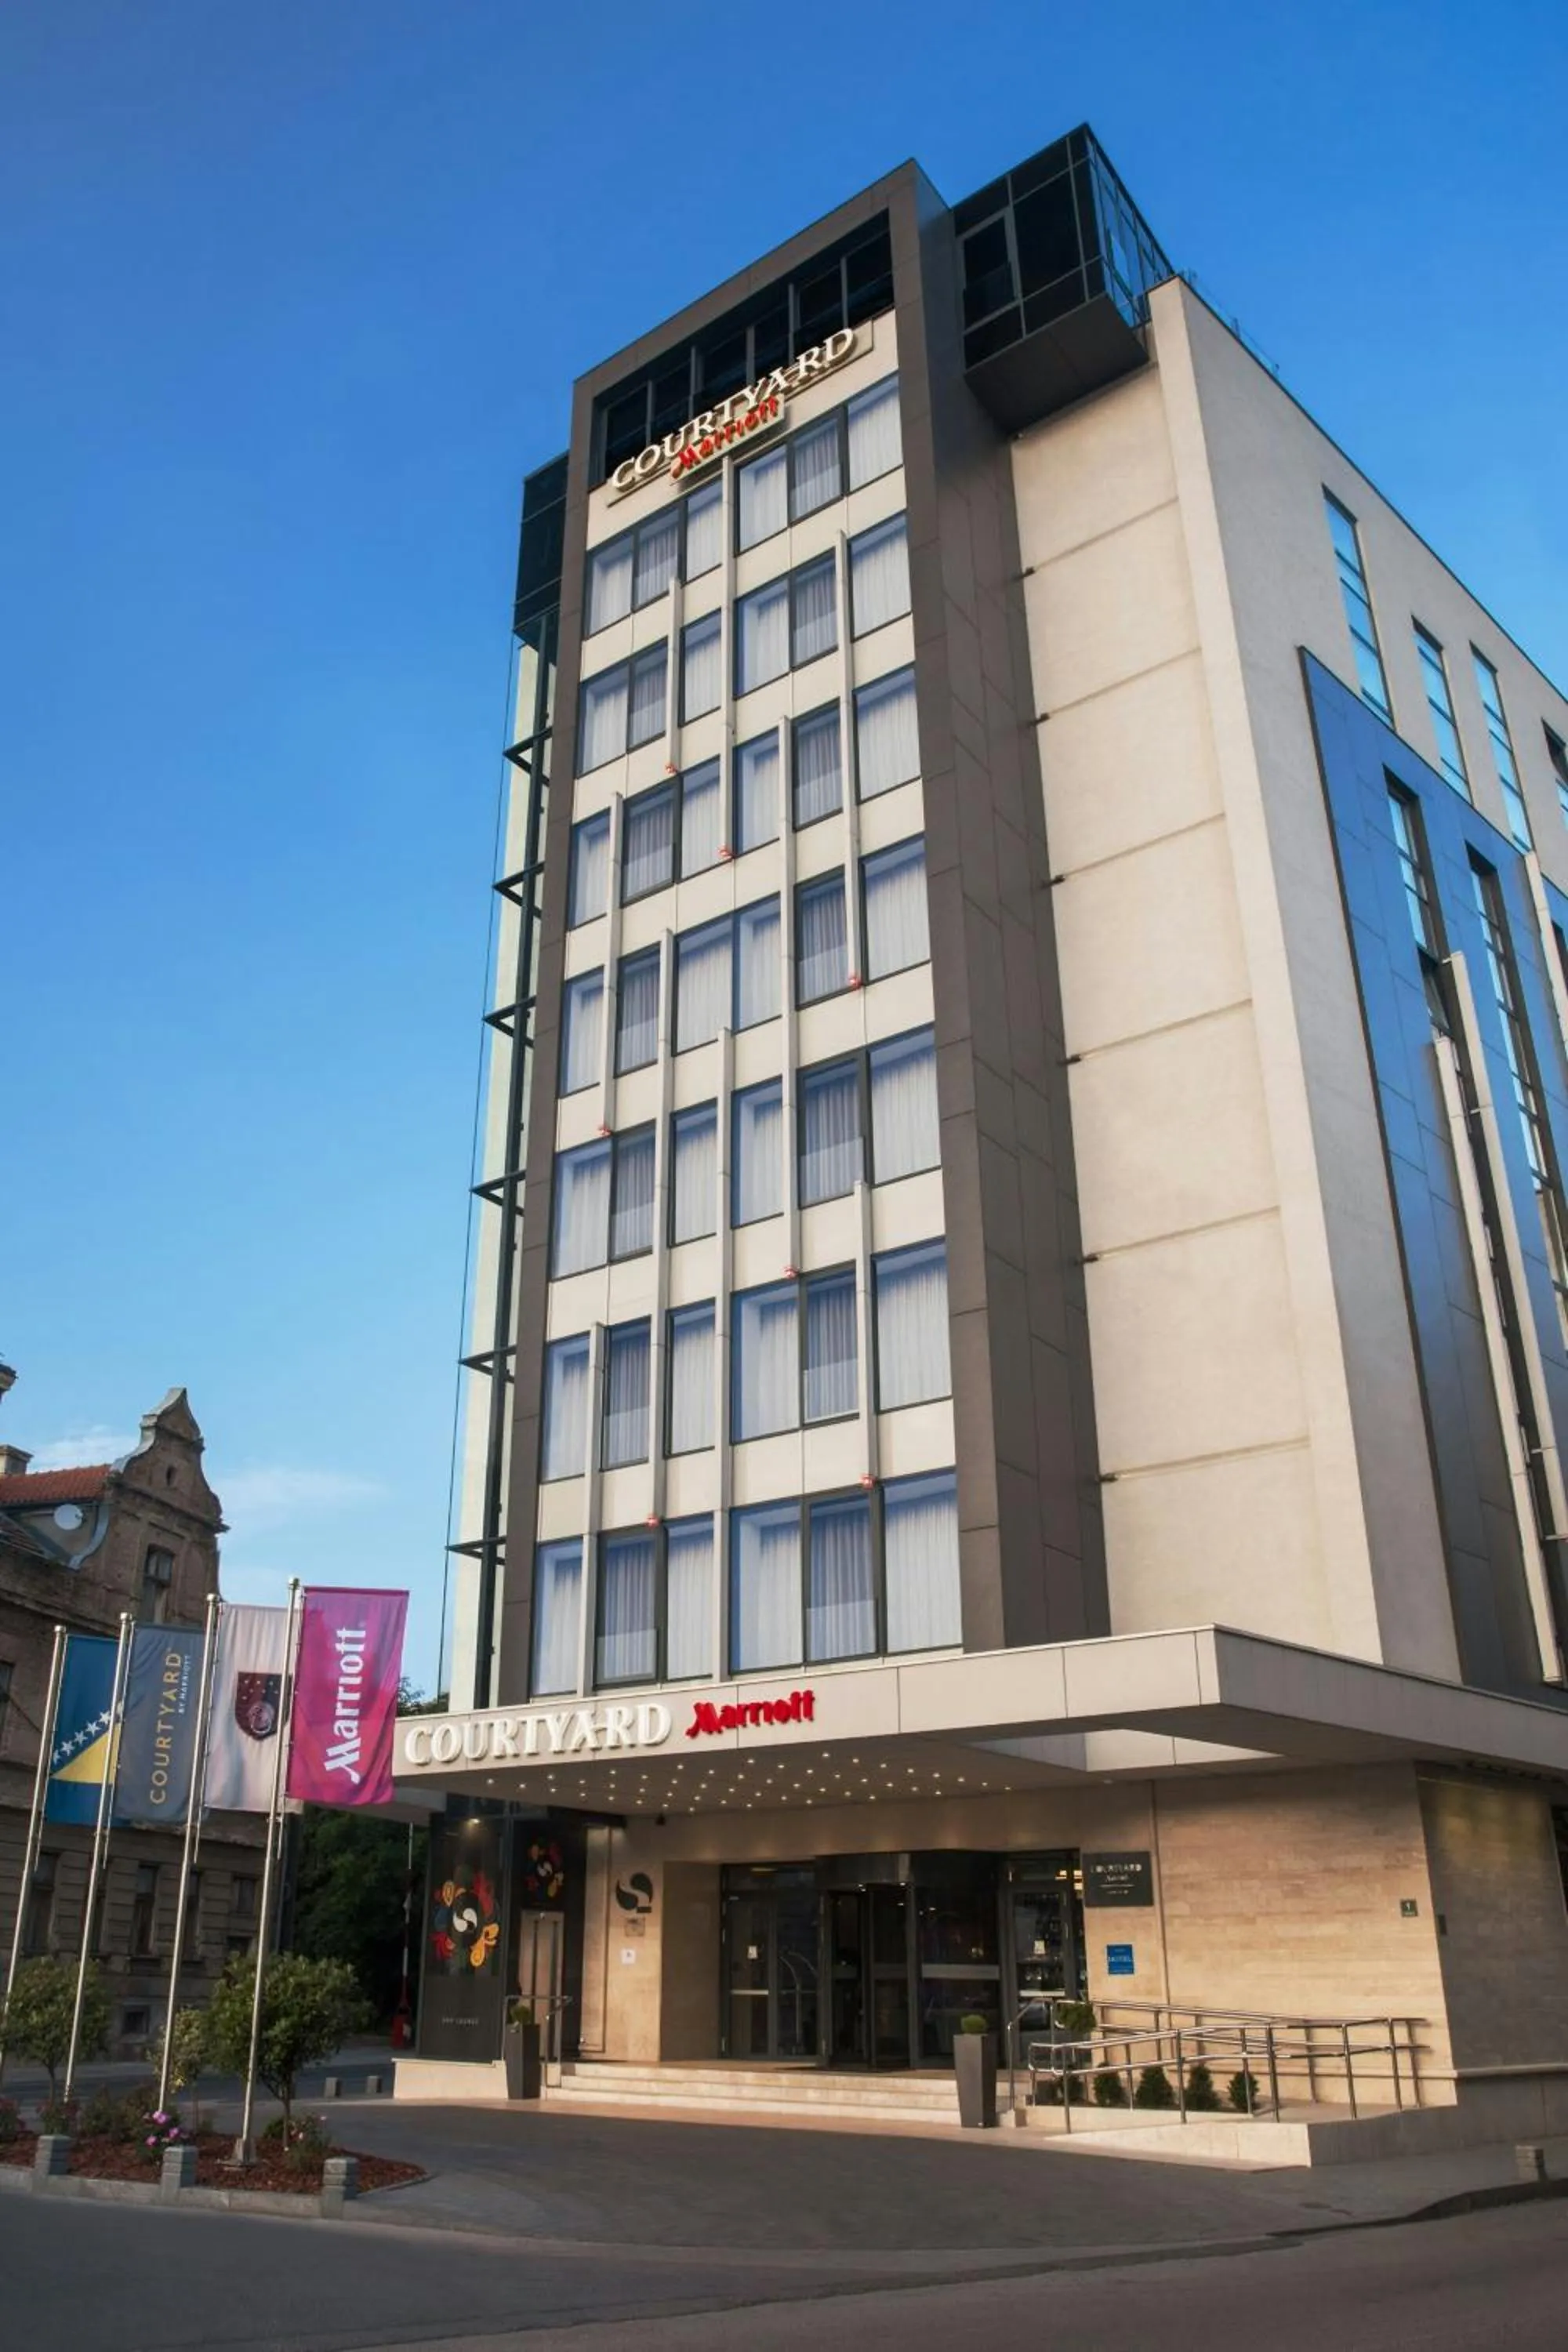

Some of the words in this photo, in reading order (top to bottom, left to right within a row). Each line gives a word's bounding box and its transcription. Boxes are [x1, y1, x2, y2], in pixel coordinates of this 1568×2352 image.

[611, 327, 856, 492] COURTYARD
[670, 394, 779, 479] Marriott
[150, 1653, 182, 1804] COURTYARD
[324, 1627, 366, 1784] Marriott
[405, 1702, 673, 1766] COURTYARD
[686, 1690, 815, 1738] Marriott
